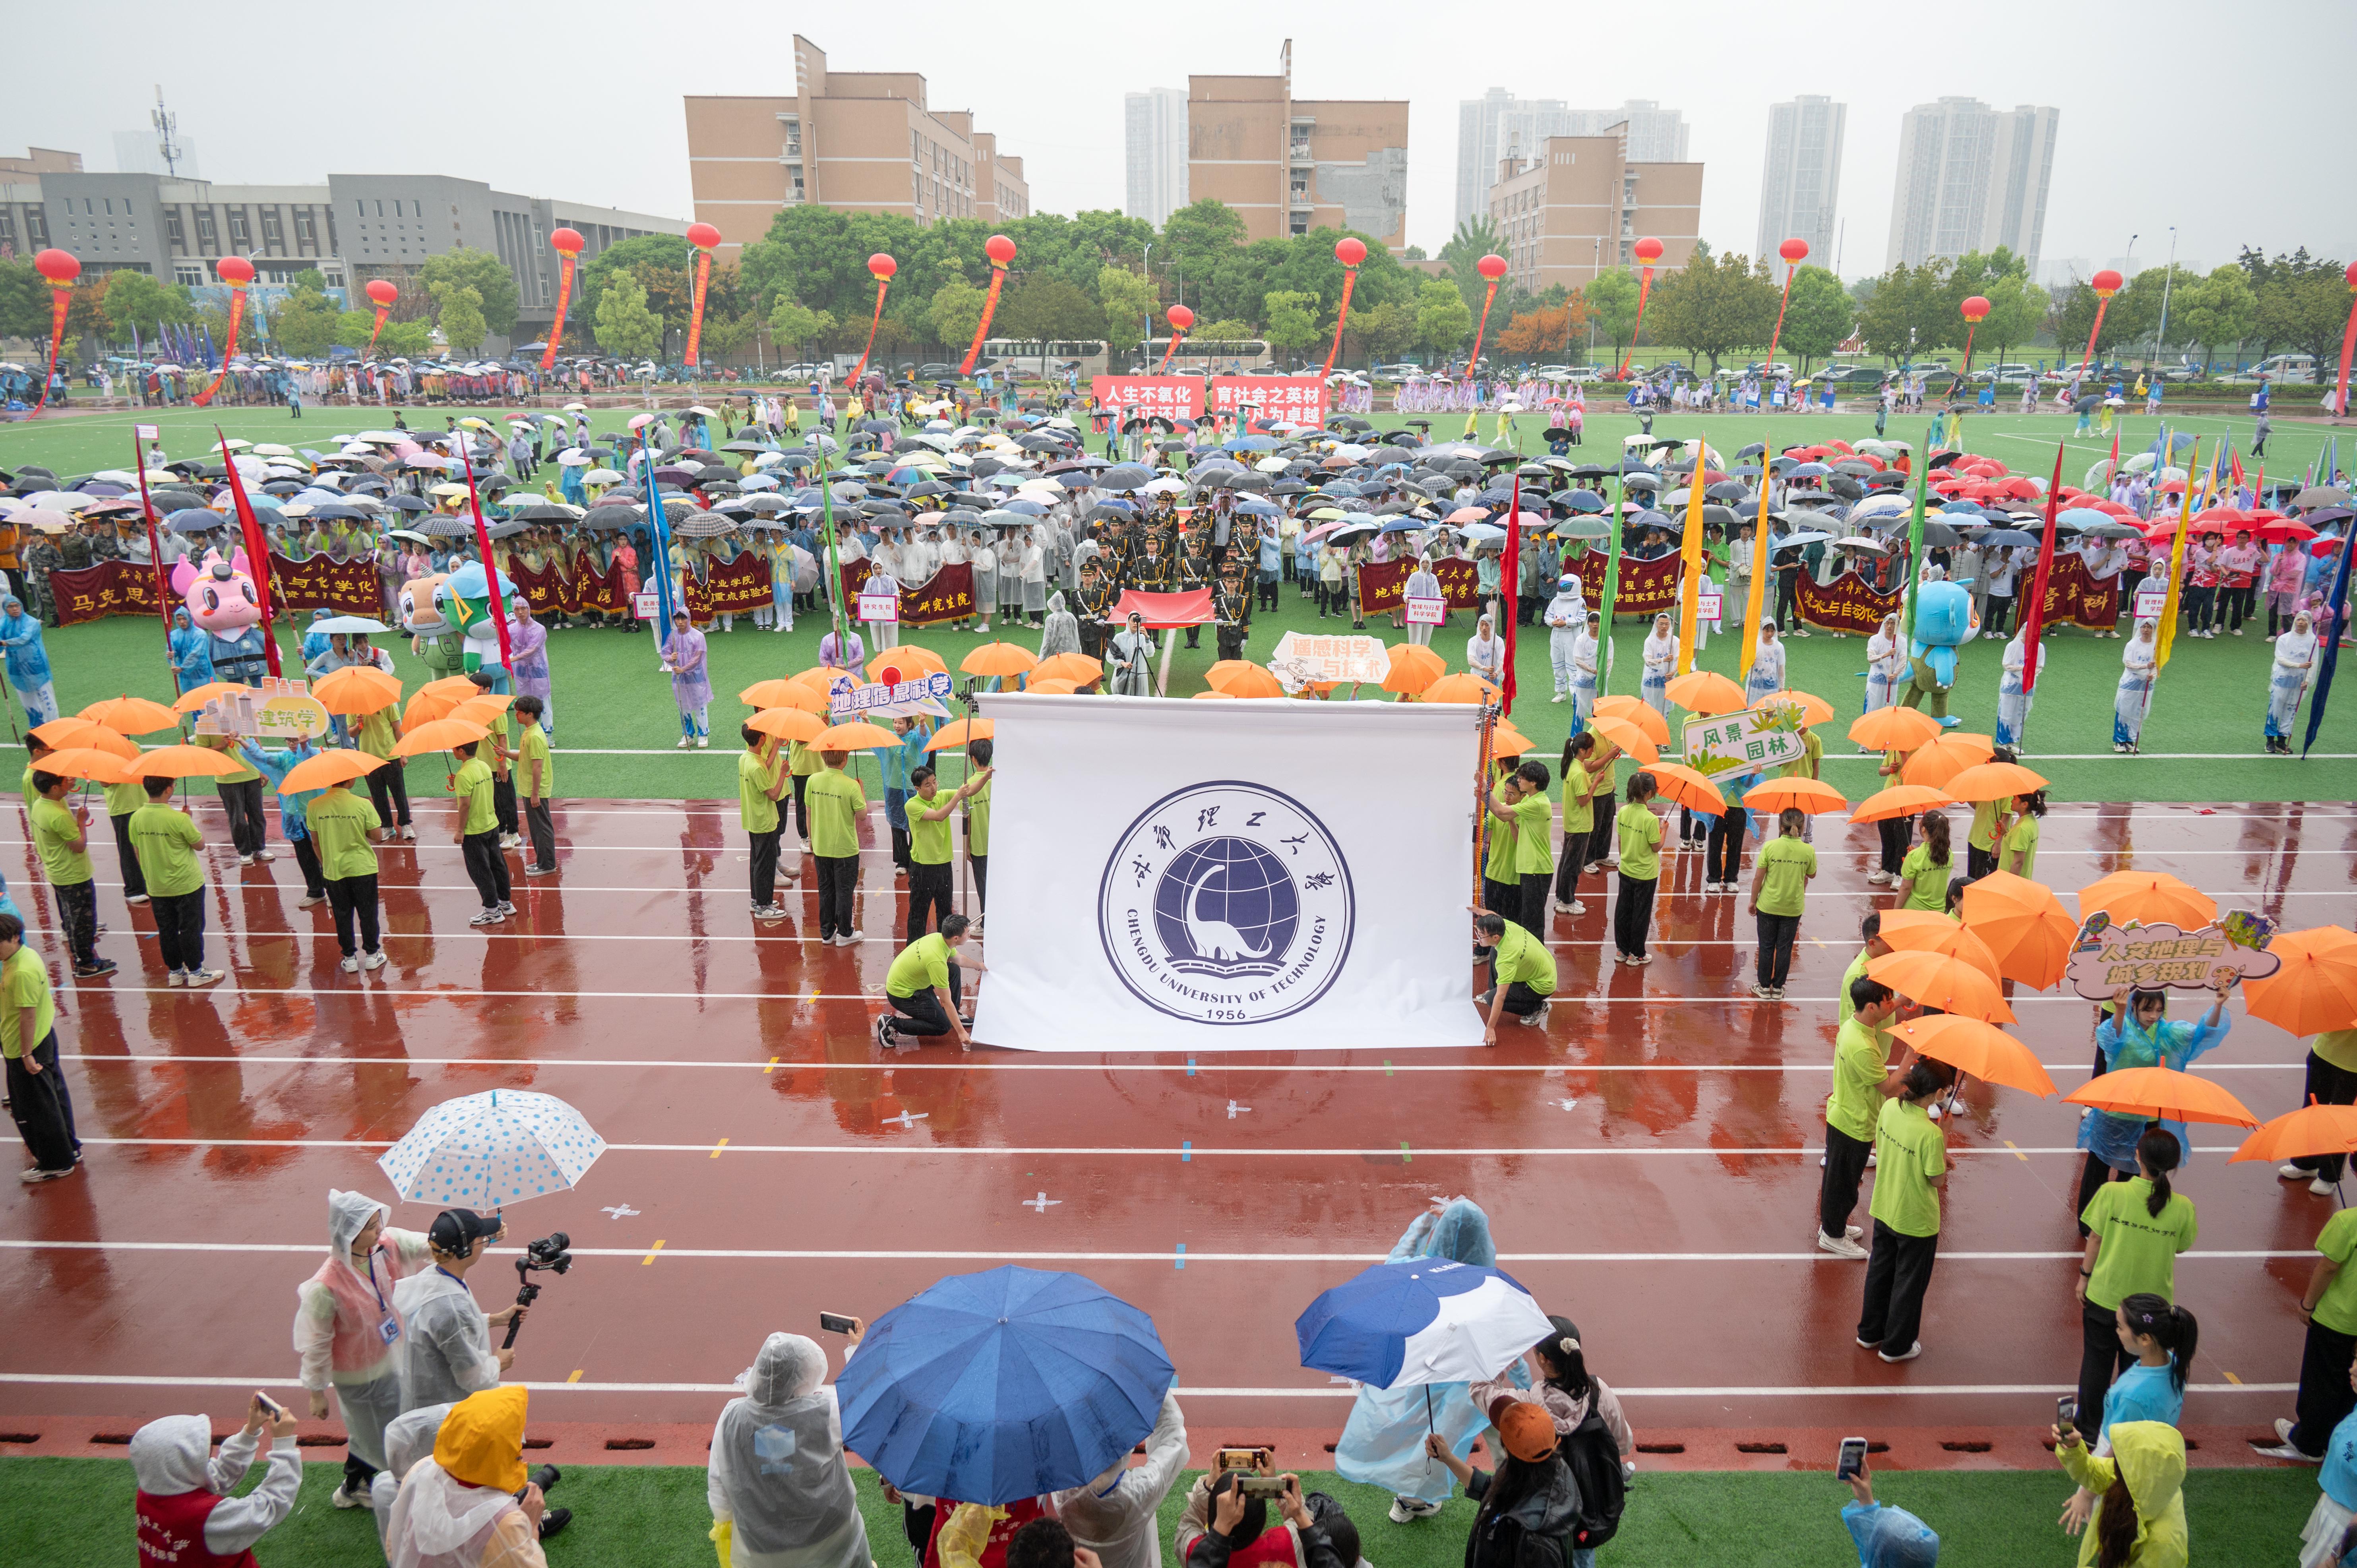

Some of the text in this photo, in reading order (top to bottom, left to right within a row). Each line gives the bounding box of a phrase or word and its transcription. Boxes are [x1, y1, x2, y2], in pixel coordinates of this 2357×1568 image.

[1106, 385, 1191, 403] 人生不氧化
[1216, 386, 1320, 404] 育社会之英材
[72, 587, 186, 611] 马克思主
[1292, 635, 1372, 659] 遥感科学
[1323, 658, 1382, 680] 与技术
[832, 673, 951, 714] 地理信息科学
[257, 709, 318, 729] 建筑学
[1703, 723, 1743, 747] 风景
[1745, 736, 1790, 762] 园林
[1126, 908, 1327, 1004] CHENGDU UNIVERSITY OF TECHNOLOGY
[2097, 939, 2227, 962] 人文地理与
[2105, 960, 2212, 985] 城乡规划
[1206, 1009, 1246, 1020] 1956
